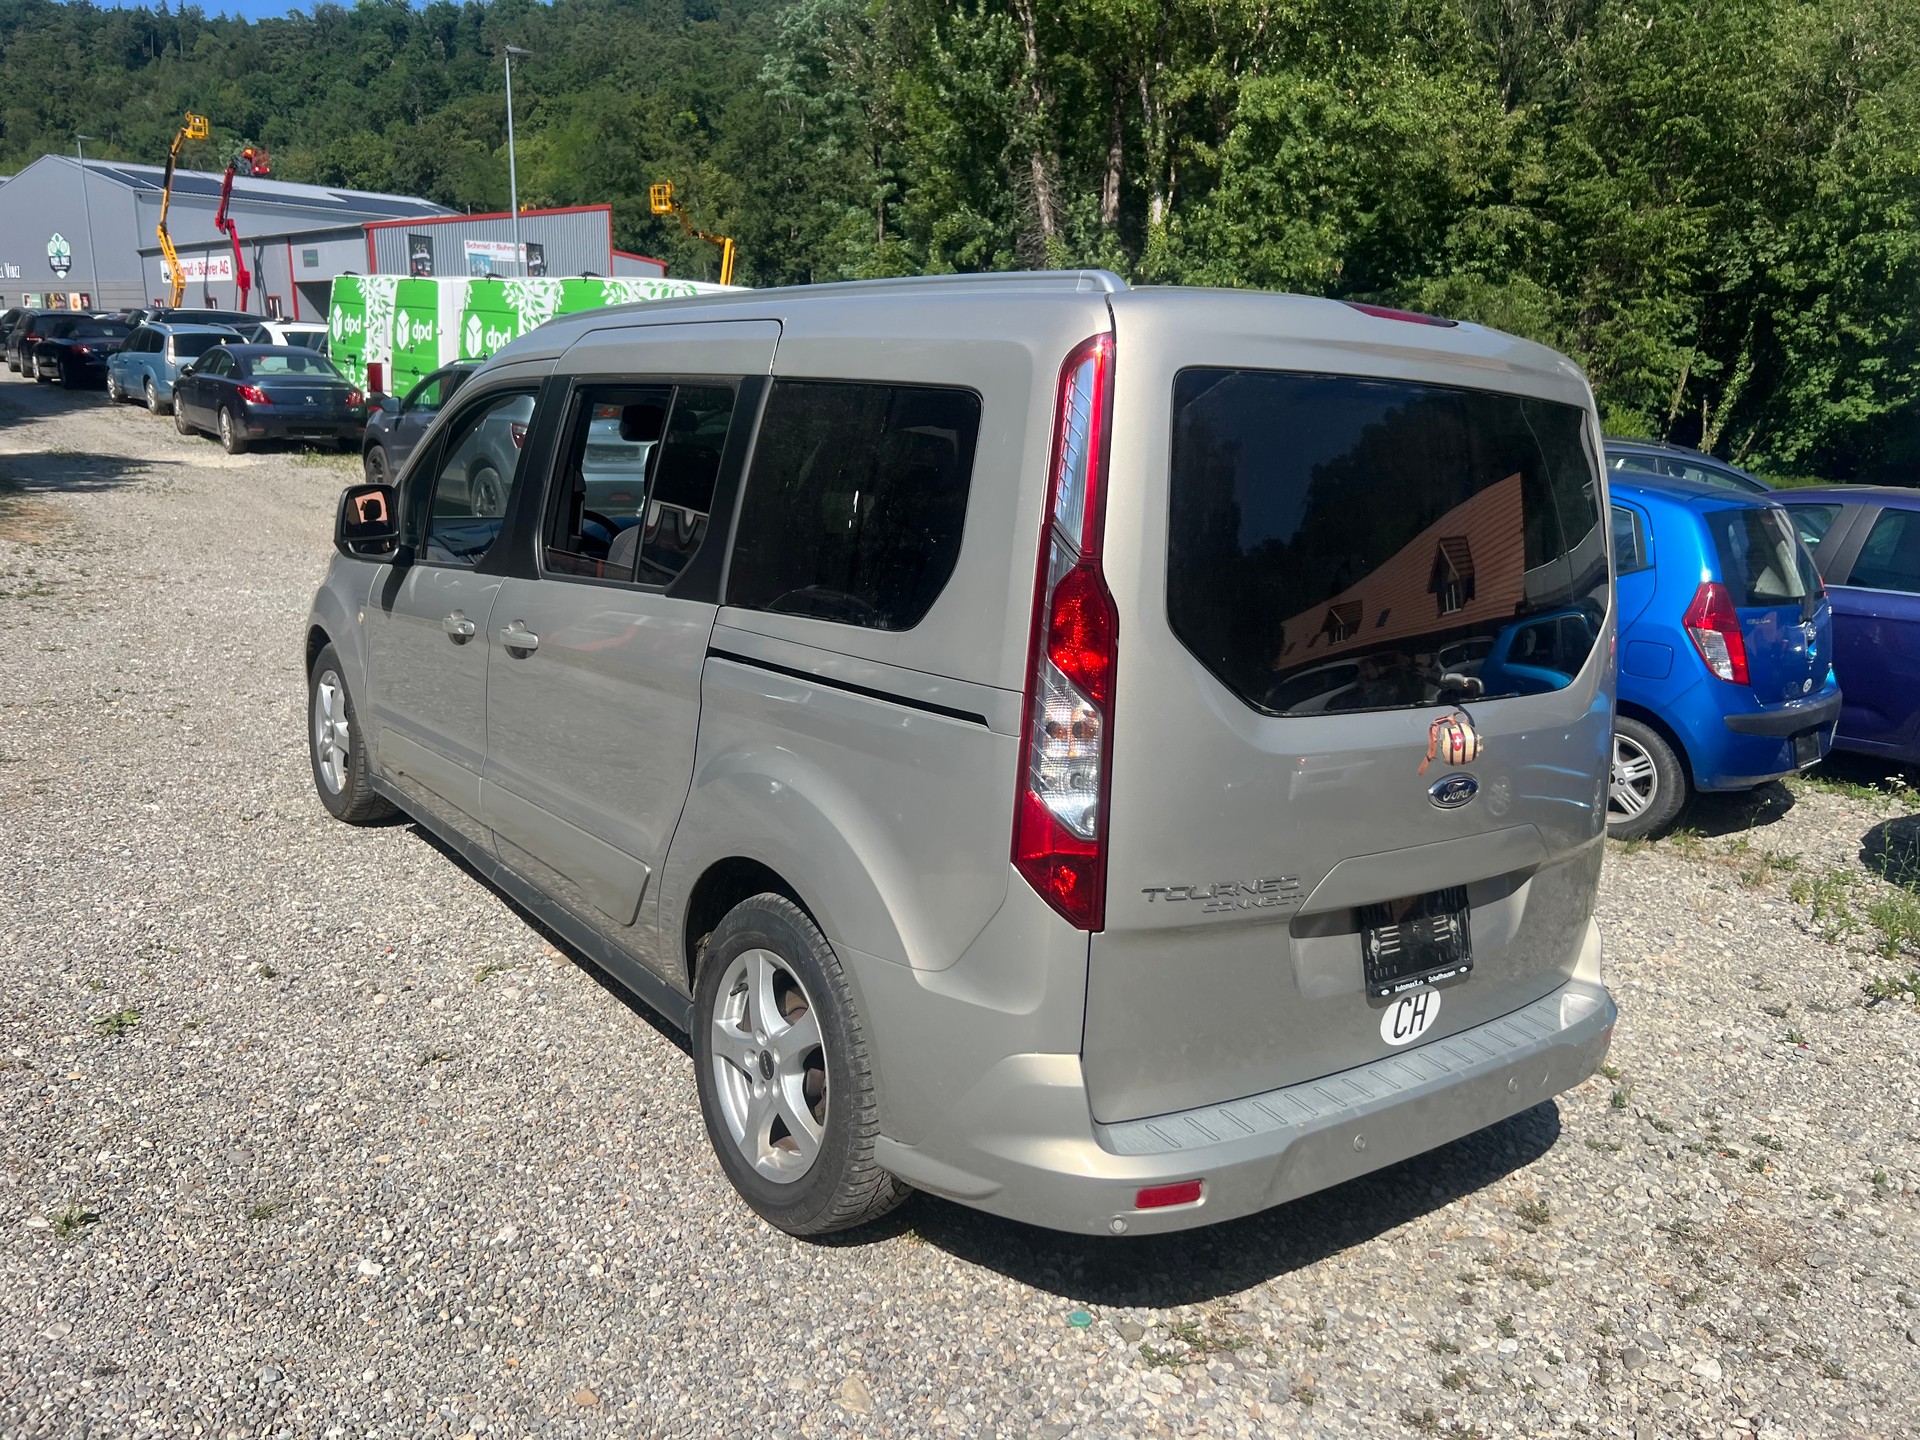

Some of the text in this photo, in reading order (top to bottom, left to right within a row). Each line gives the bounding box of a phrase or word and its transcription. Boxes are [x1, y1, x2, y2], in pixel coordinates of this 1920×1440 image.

[466, 241, 491, 250] Schmid
[220, 259, 229, 275] AG
[344, 313, 362, 337] dpd
[412, 318, 433, 344] dpd
[486, 325, 512, 353] dpd
[1141, 875, 1300, 902] TOURNEO
[1202, 893, 1304, 913] CONNECT
[1393, 991, 1430, 1039] CH
